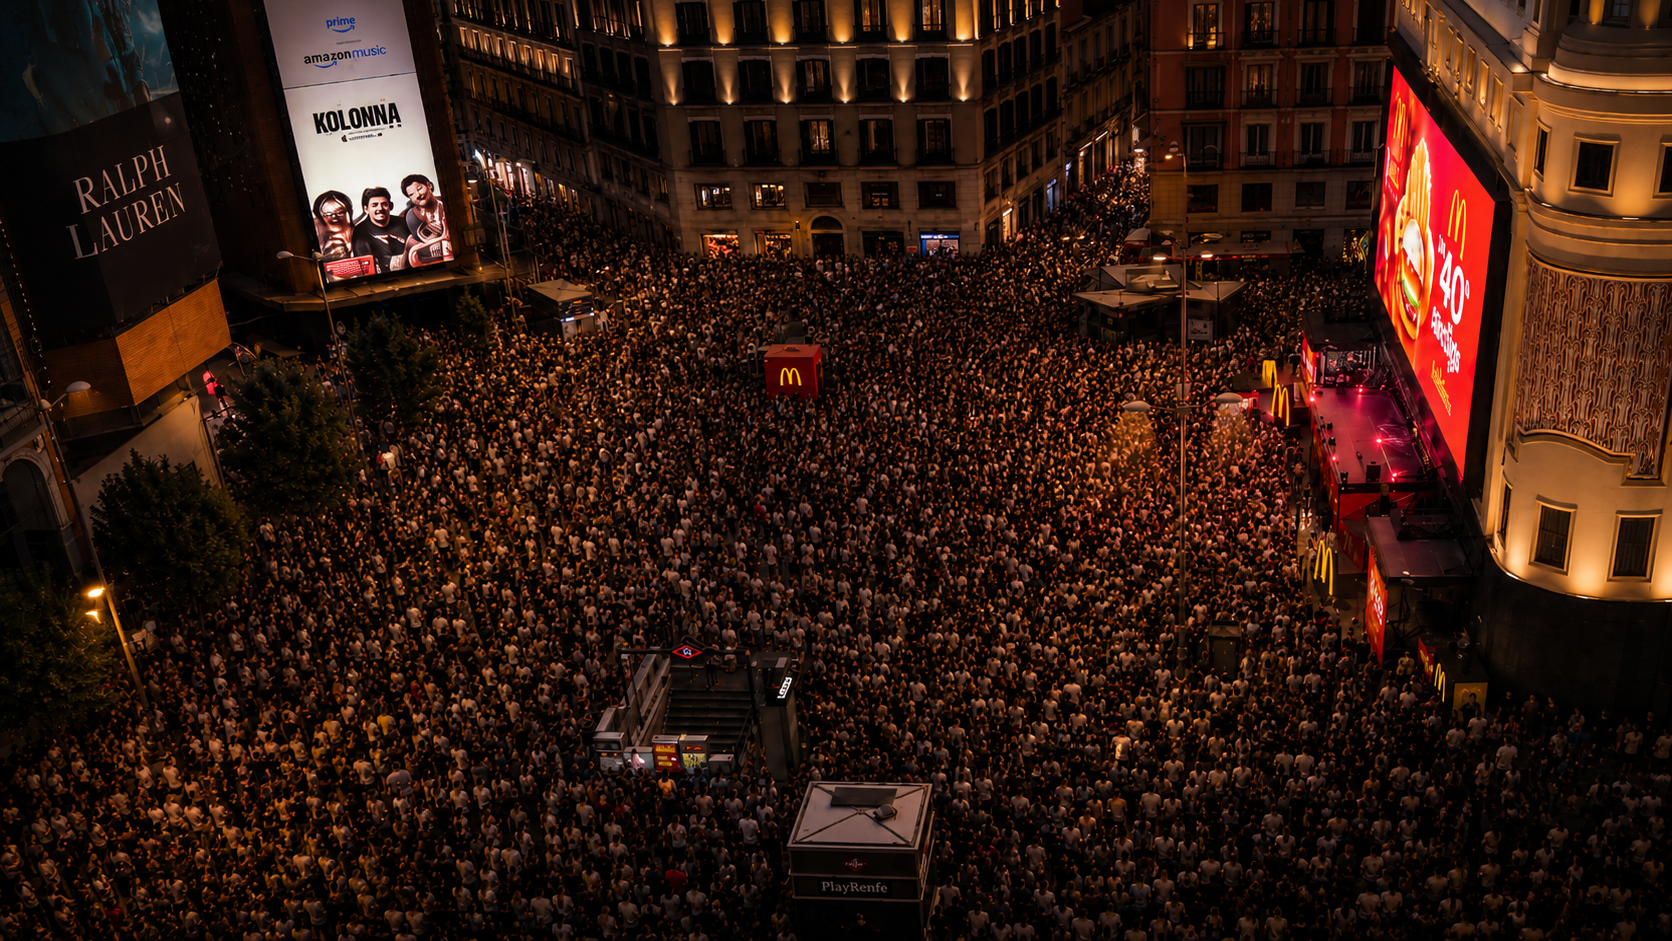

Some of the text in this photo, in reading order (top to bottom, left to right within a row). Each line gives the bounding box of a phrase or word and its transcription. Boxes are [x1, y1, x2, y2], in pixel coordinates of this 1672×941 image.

[326, 16, 356, 29] prime
[74, 145, 172, 214] RALPH
[66, 182, 185, 259] LAUREN
[821, 881, 888, 895] PlayRenfe
